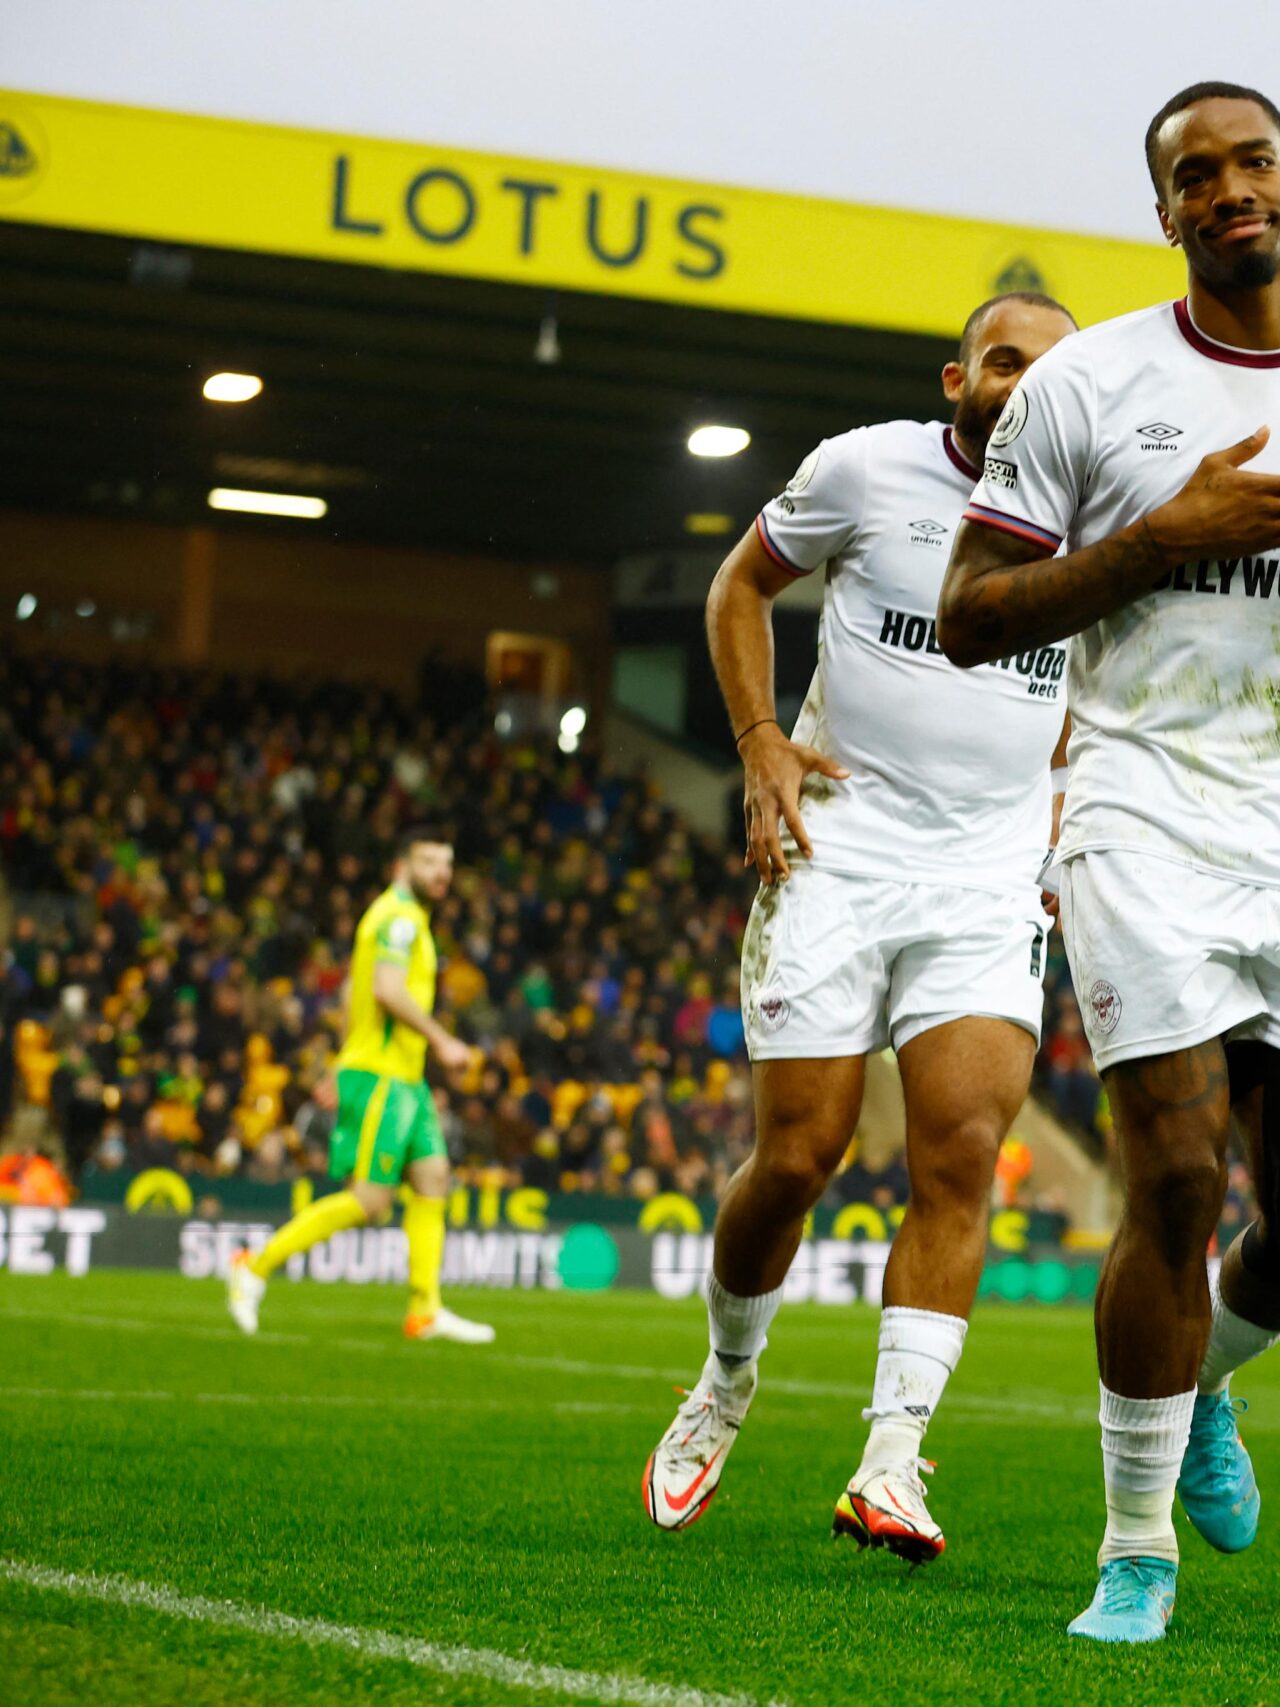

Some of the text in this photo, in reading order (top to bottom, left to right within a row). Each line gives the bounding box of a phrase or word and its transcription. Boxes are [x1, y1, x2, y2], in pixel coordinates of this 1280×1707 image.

[332, 154, 727, 281] LOTUS
[1140, 442, 1178, 451] umbro
[910, 535, 943, 546] umbro
[1028, 676, 1058, 699] bets
[0, 1206, 106, 1276] ET
